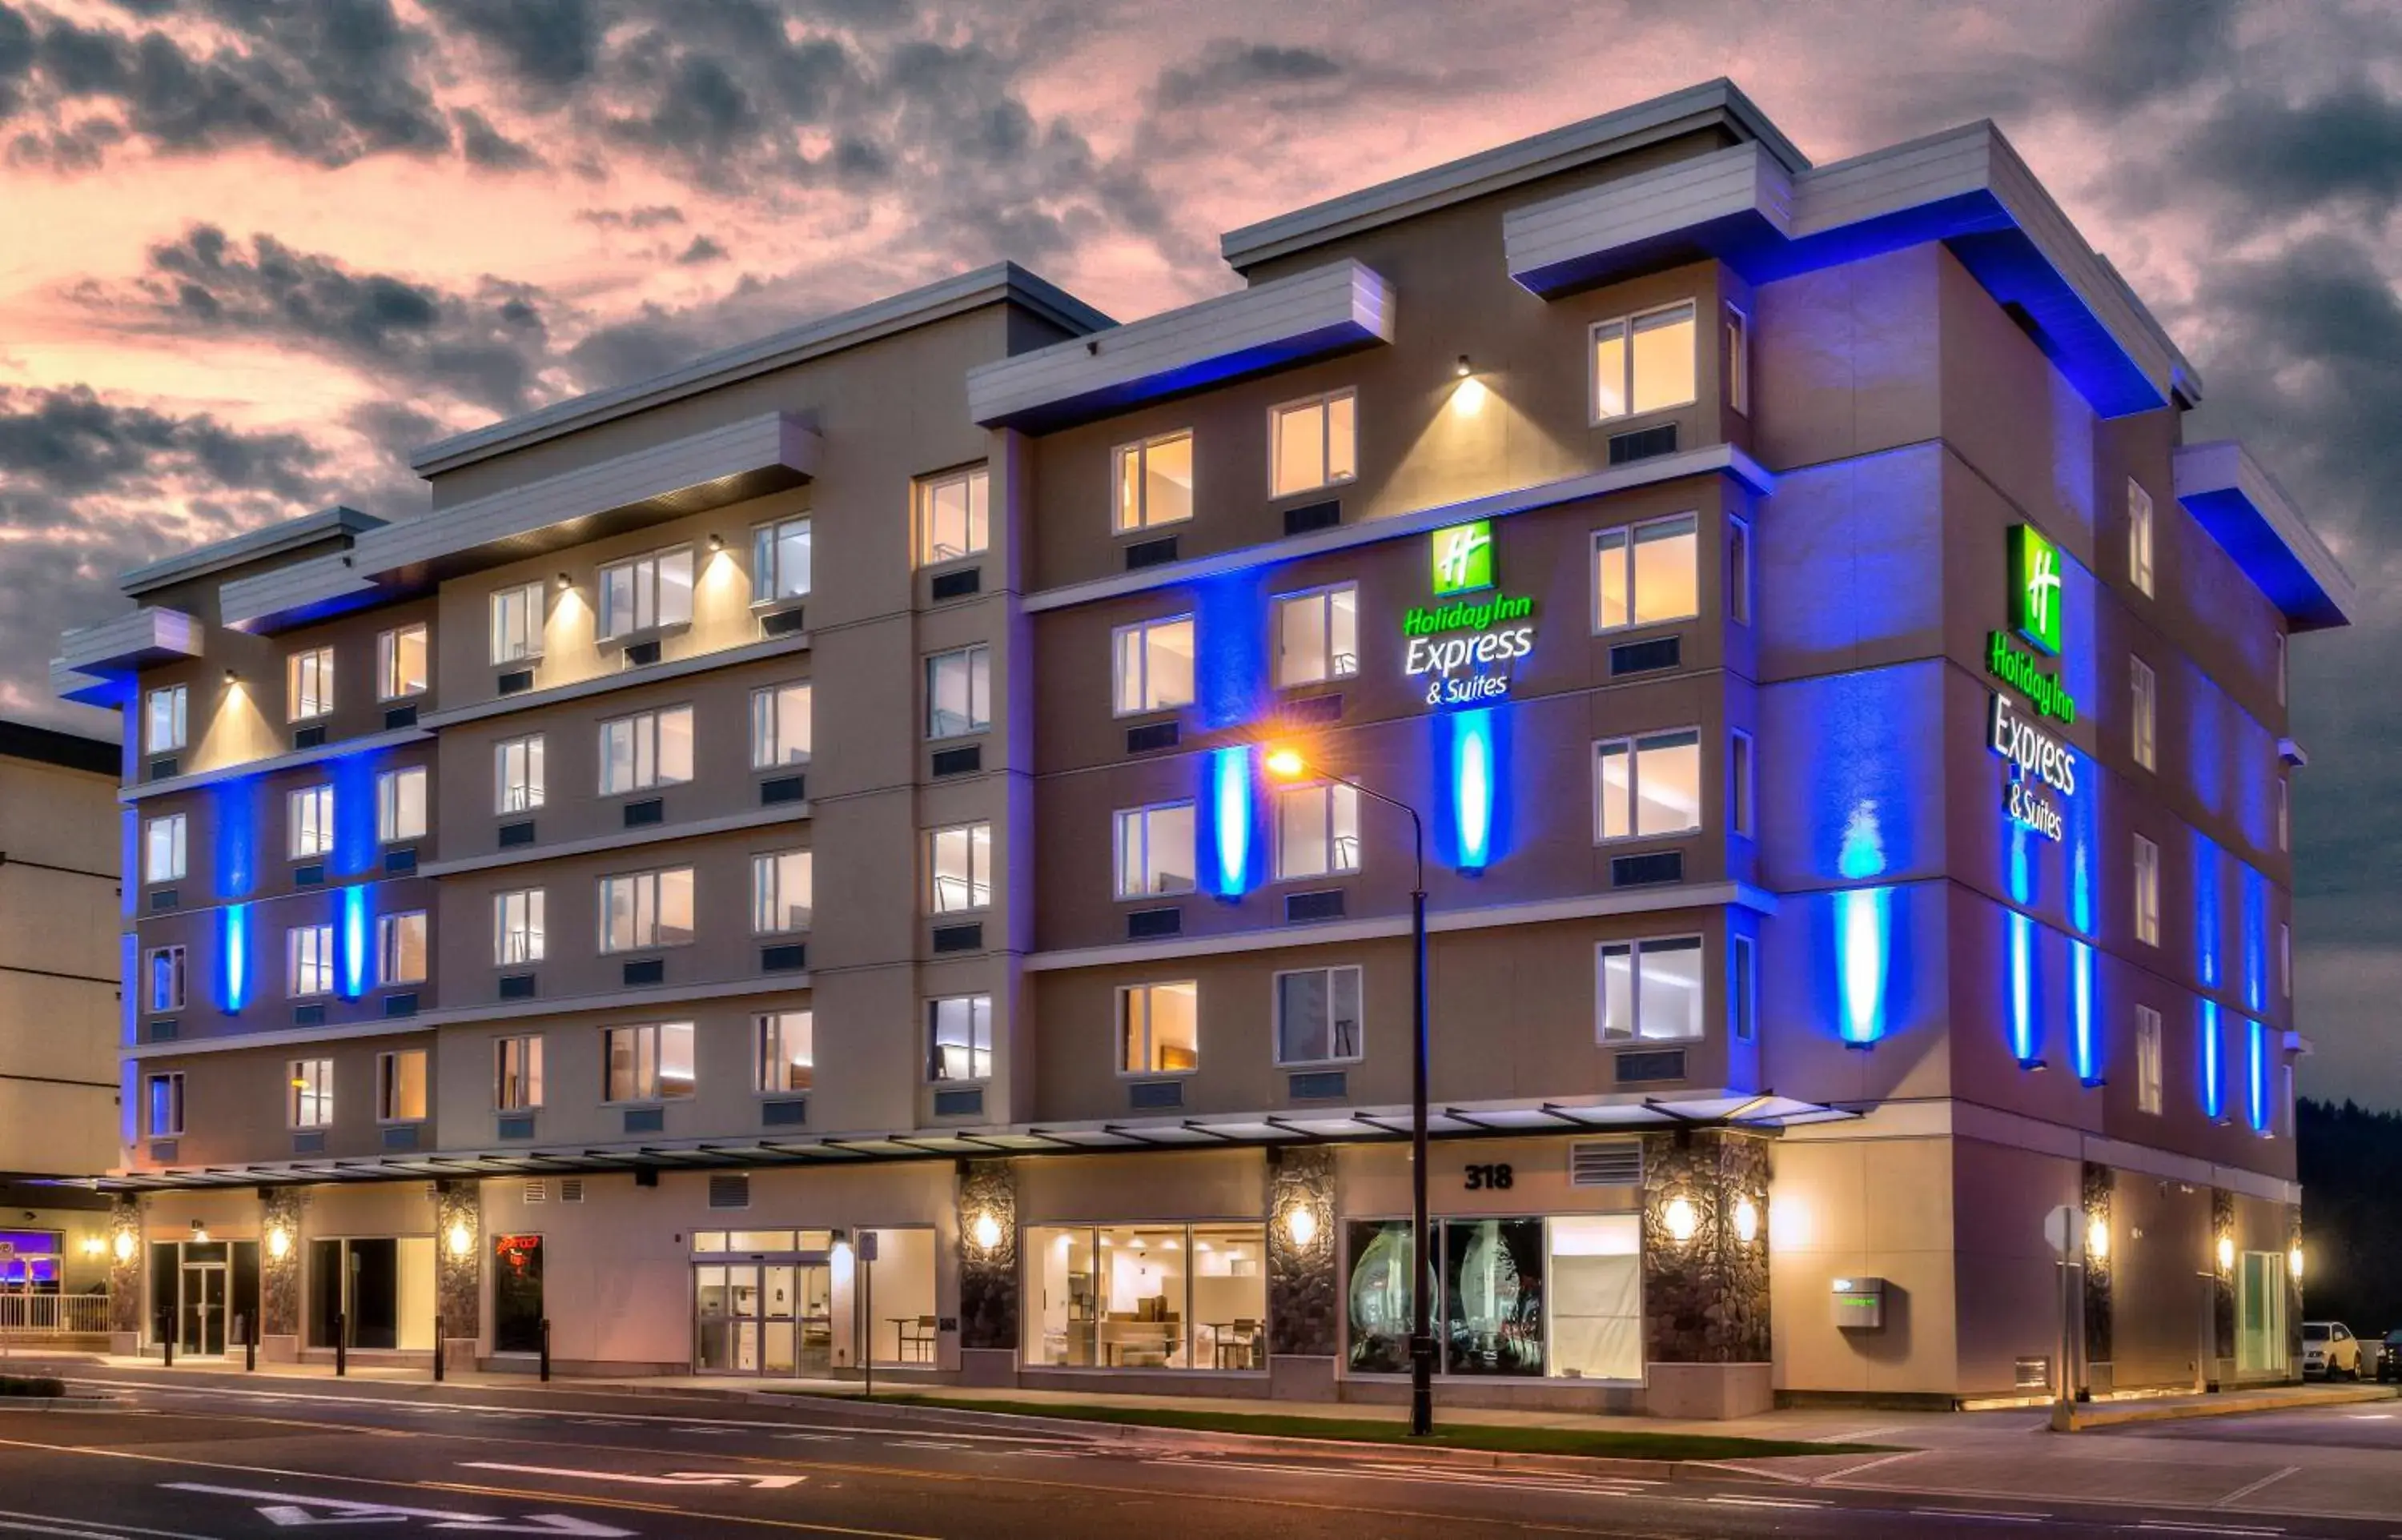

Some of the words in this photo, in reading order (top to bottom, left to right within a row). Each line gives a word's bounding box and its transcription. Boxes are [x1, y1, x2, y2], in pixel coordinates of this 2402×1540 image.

[1404, 602, 1491, 636] Holiday
[1492, 593, 1532, 620] Inn
[1405, 628, 1532, 678] Express
[1992, 630, 2051, 716] Holiday
[2051, 675, 2075, 724] Inn
[1427, 681, 1442, 704] &
[1446, 676, 1508, 701] Suites
[1994, 692, 2075, 796] Express
[2010, 783, 2022, 818] &
[2023, 792, 2063, 843] Suites
[1464, 1163, 1513, 1190] 318
